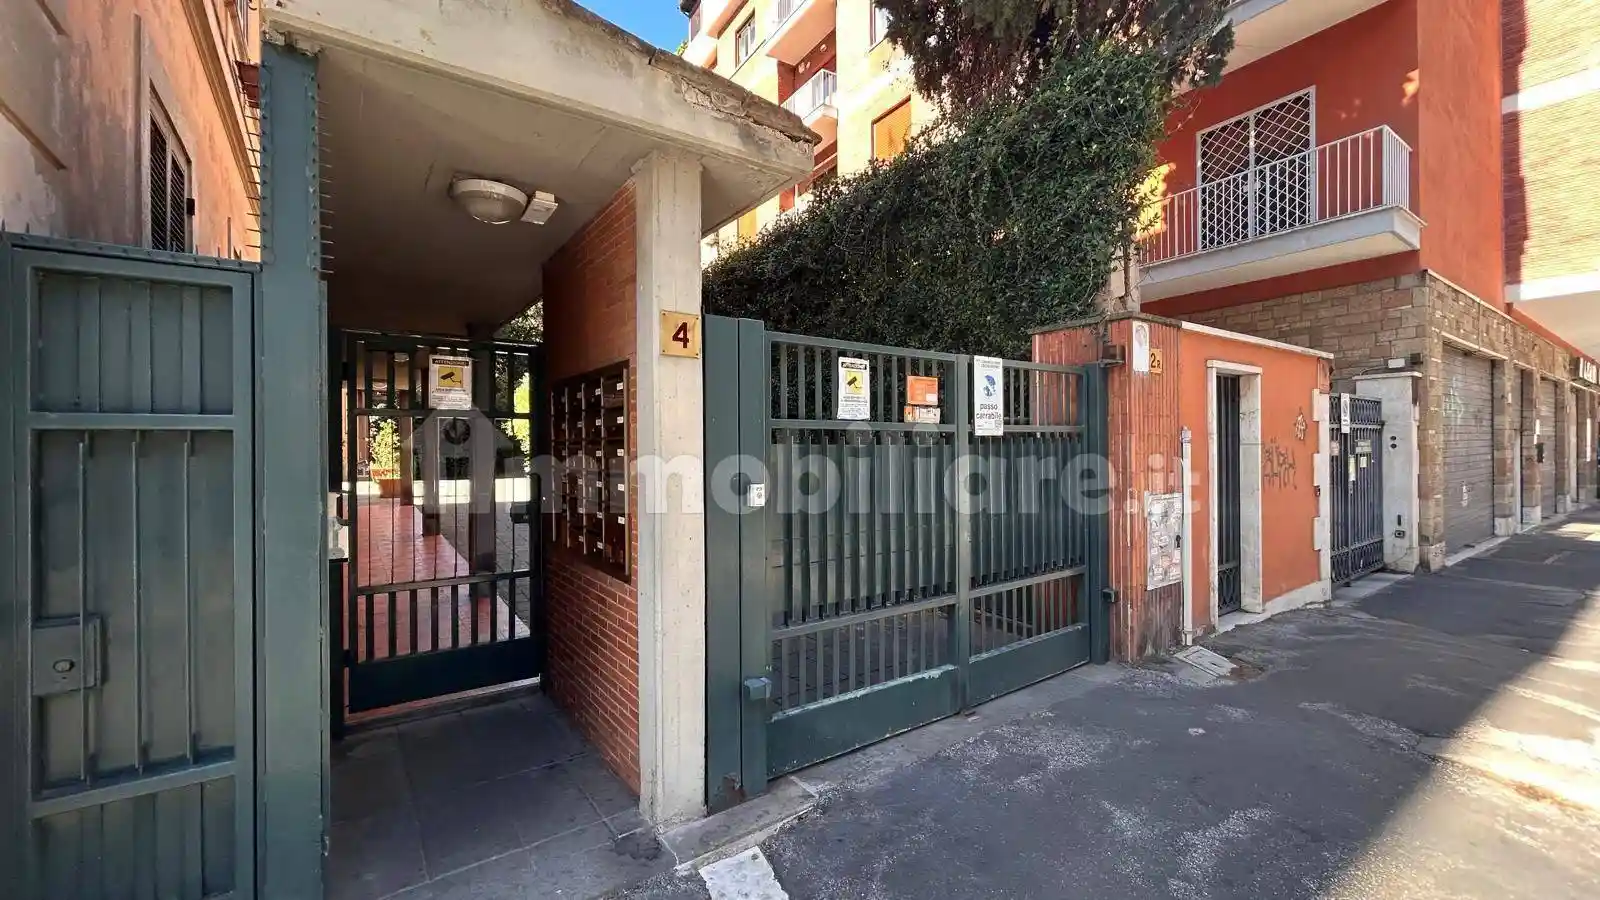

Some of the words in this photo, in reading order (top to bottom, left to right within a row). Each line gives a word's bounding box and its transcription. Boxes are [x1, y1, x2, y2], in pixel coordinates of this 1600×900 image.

[672, 321, 690, 349] 4
[980, 403, 998, 411] passo
[976, 412, 1002, 420] carrabile
